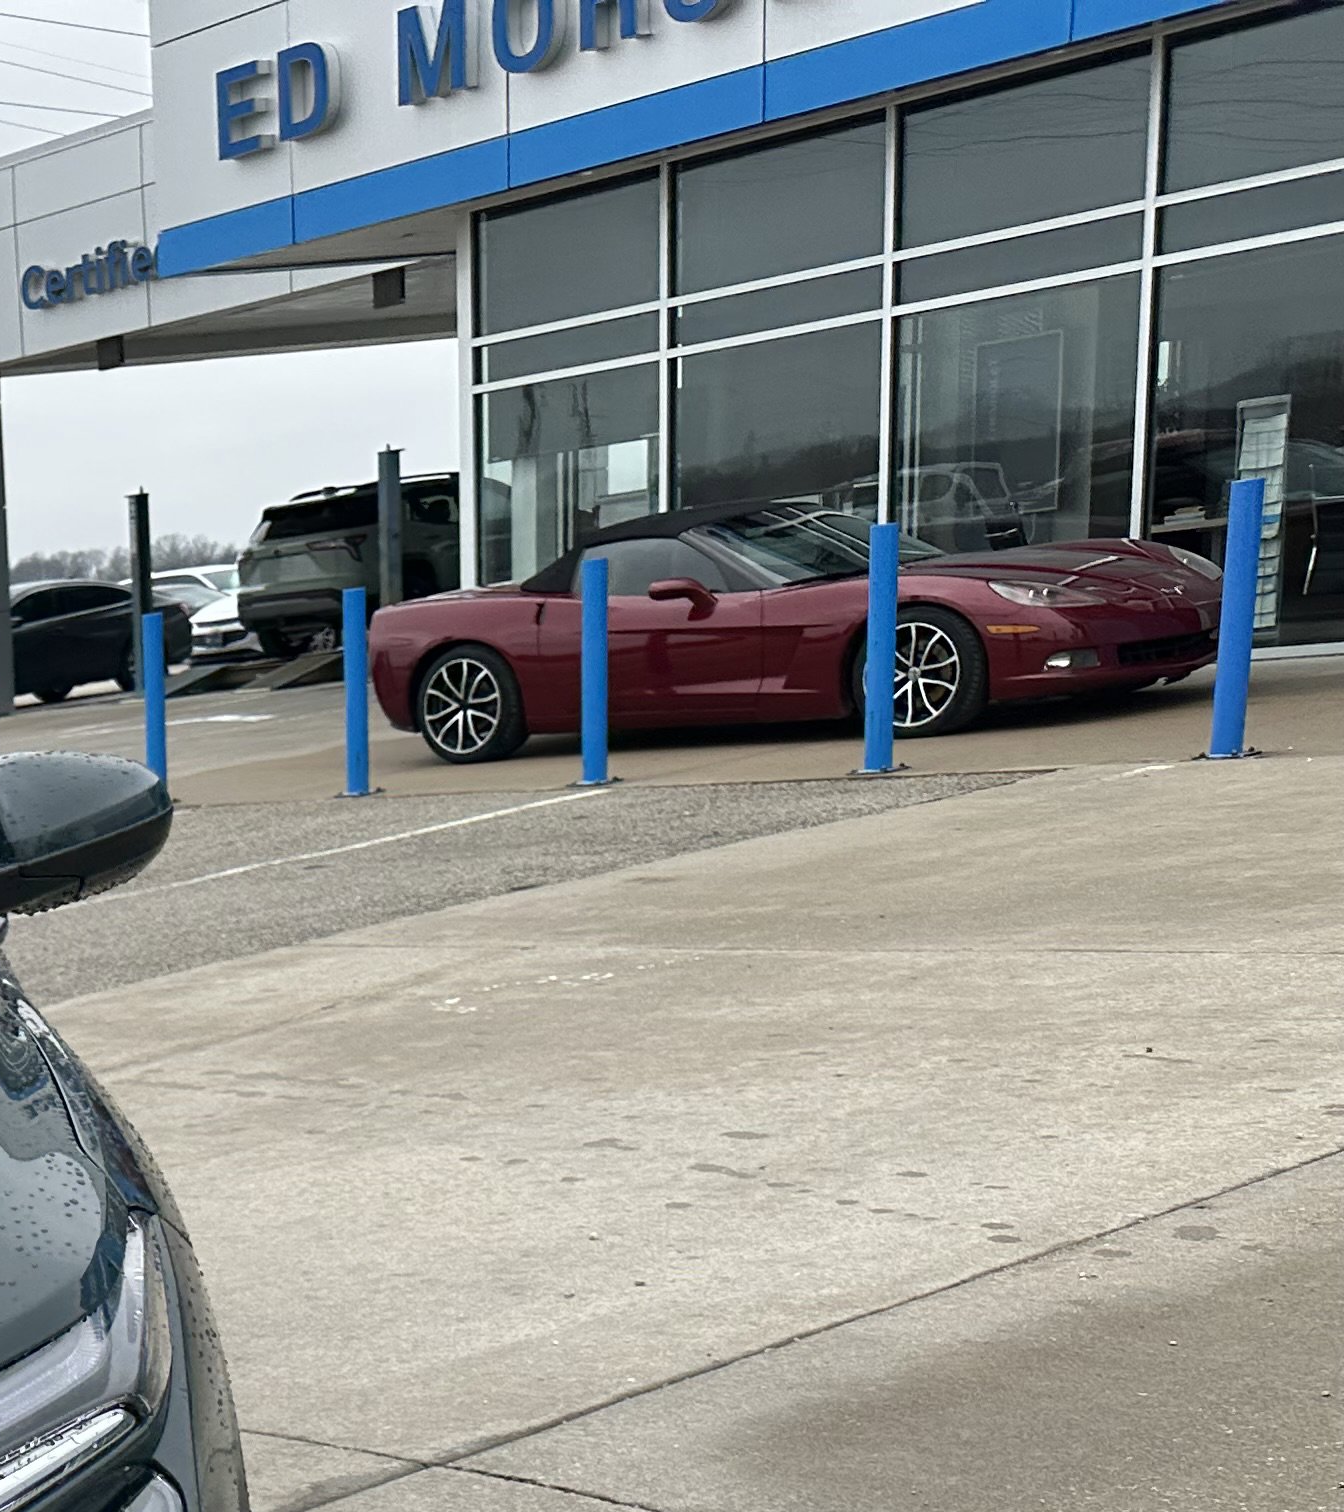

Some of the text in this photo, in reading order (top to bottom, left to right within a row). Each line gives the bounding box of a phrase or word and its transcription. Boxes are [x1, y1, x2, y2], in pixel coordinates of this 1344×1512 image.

[215, 0, 716, 161] ED MO
[22, 239, 159, 310] Certifie
